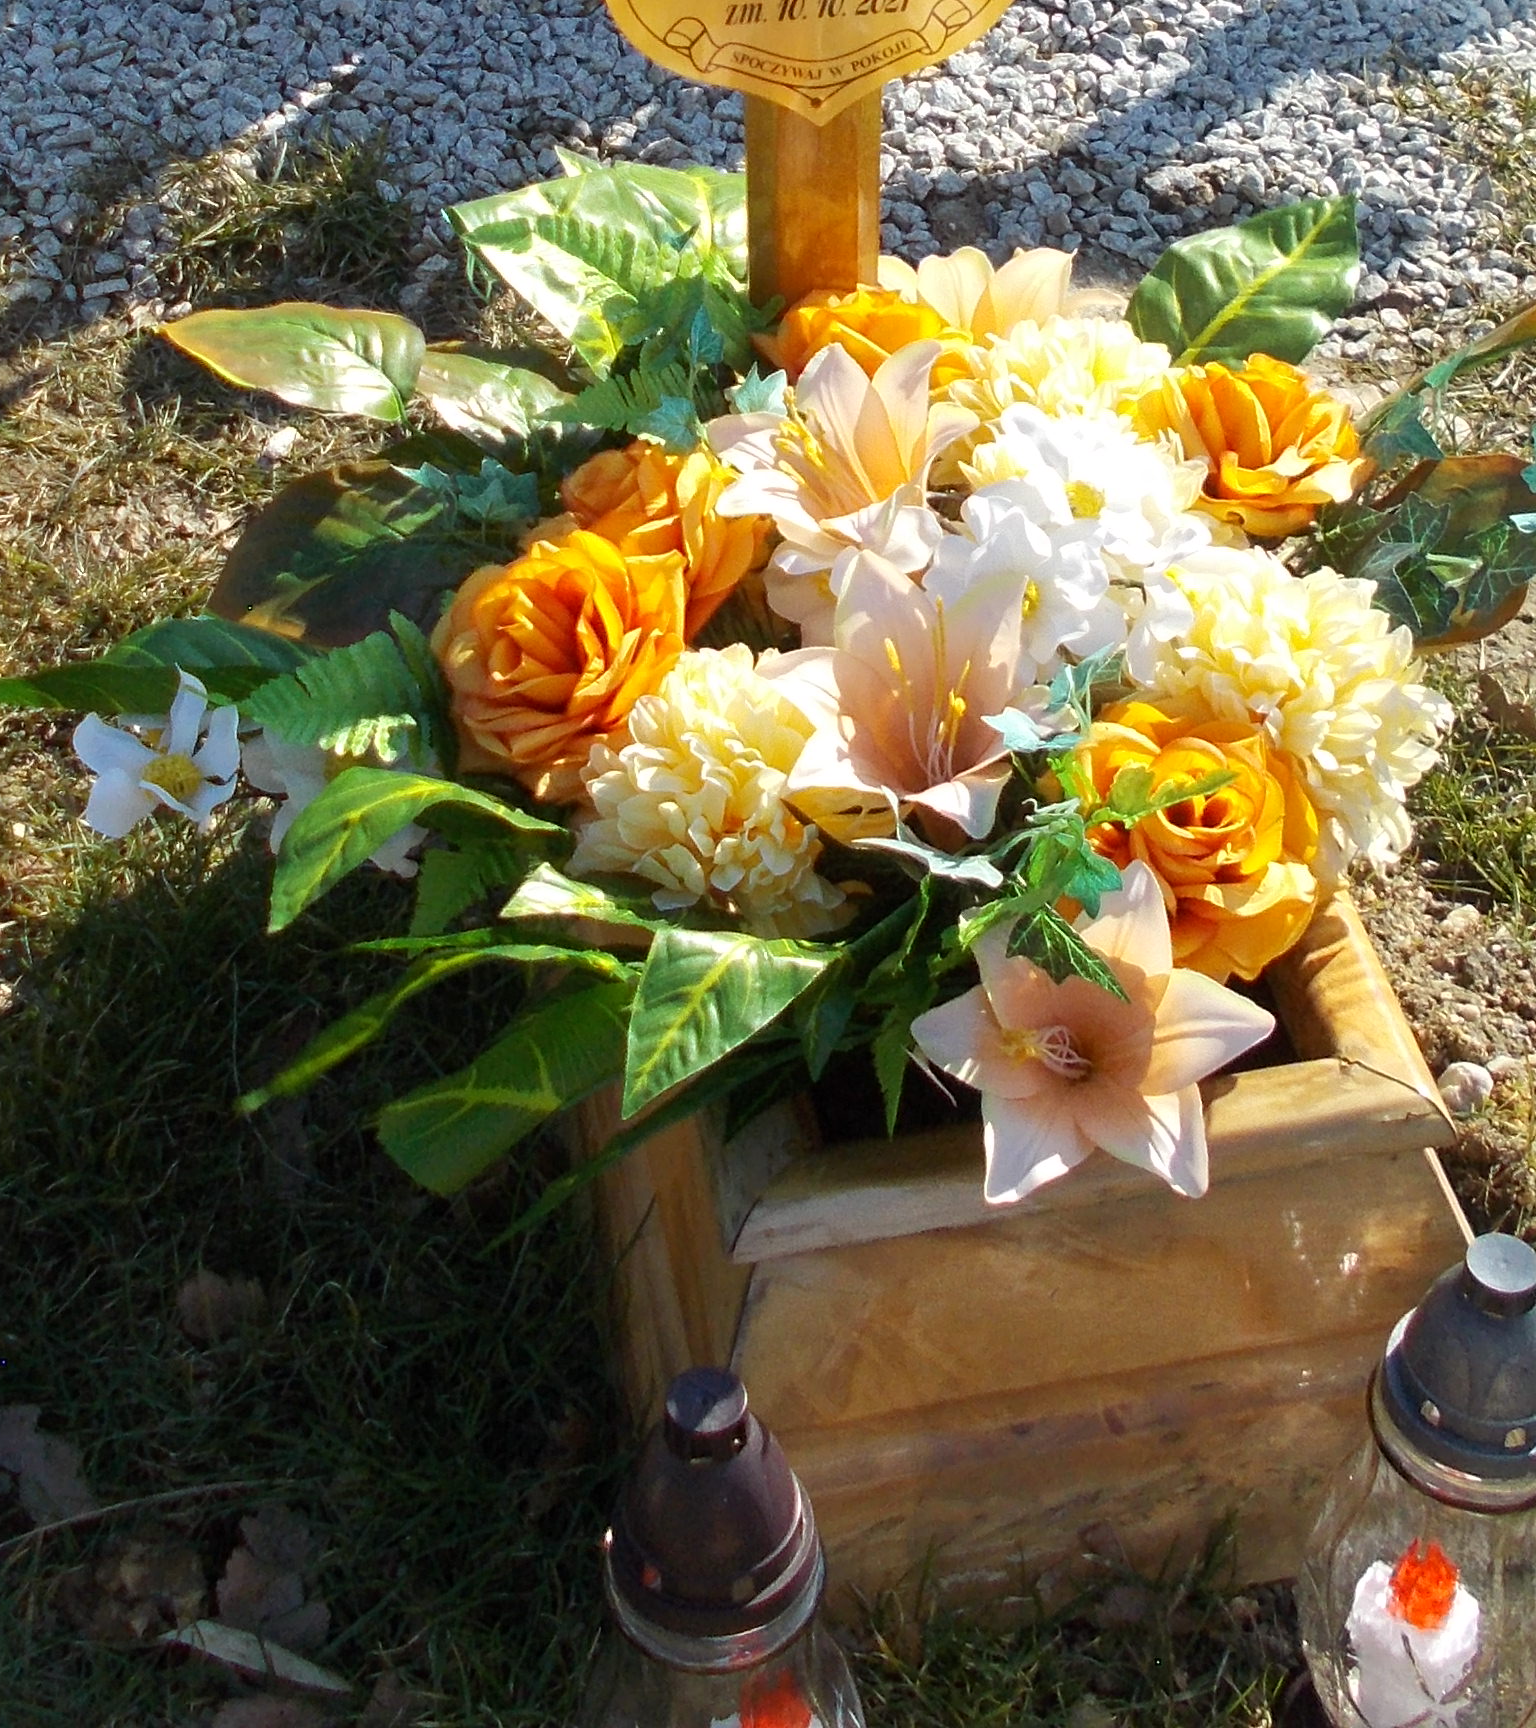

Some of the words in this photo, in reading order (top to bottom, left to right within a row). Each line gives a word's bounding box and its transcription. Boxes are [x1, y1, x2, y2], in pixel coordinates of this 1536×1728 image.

[724, 1, 767, 27] zm.
[730, 51, 826, 81] SPOCZYWAJ
[830, 65, 847, 78] W
[850, 38, 913, 73] POKOJU
